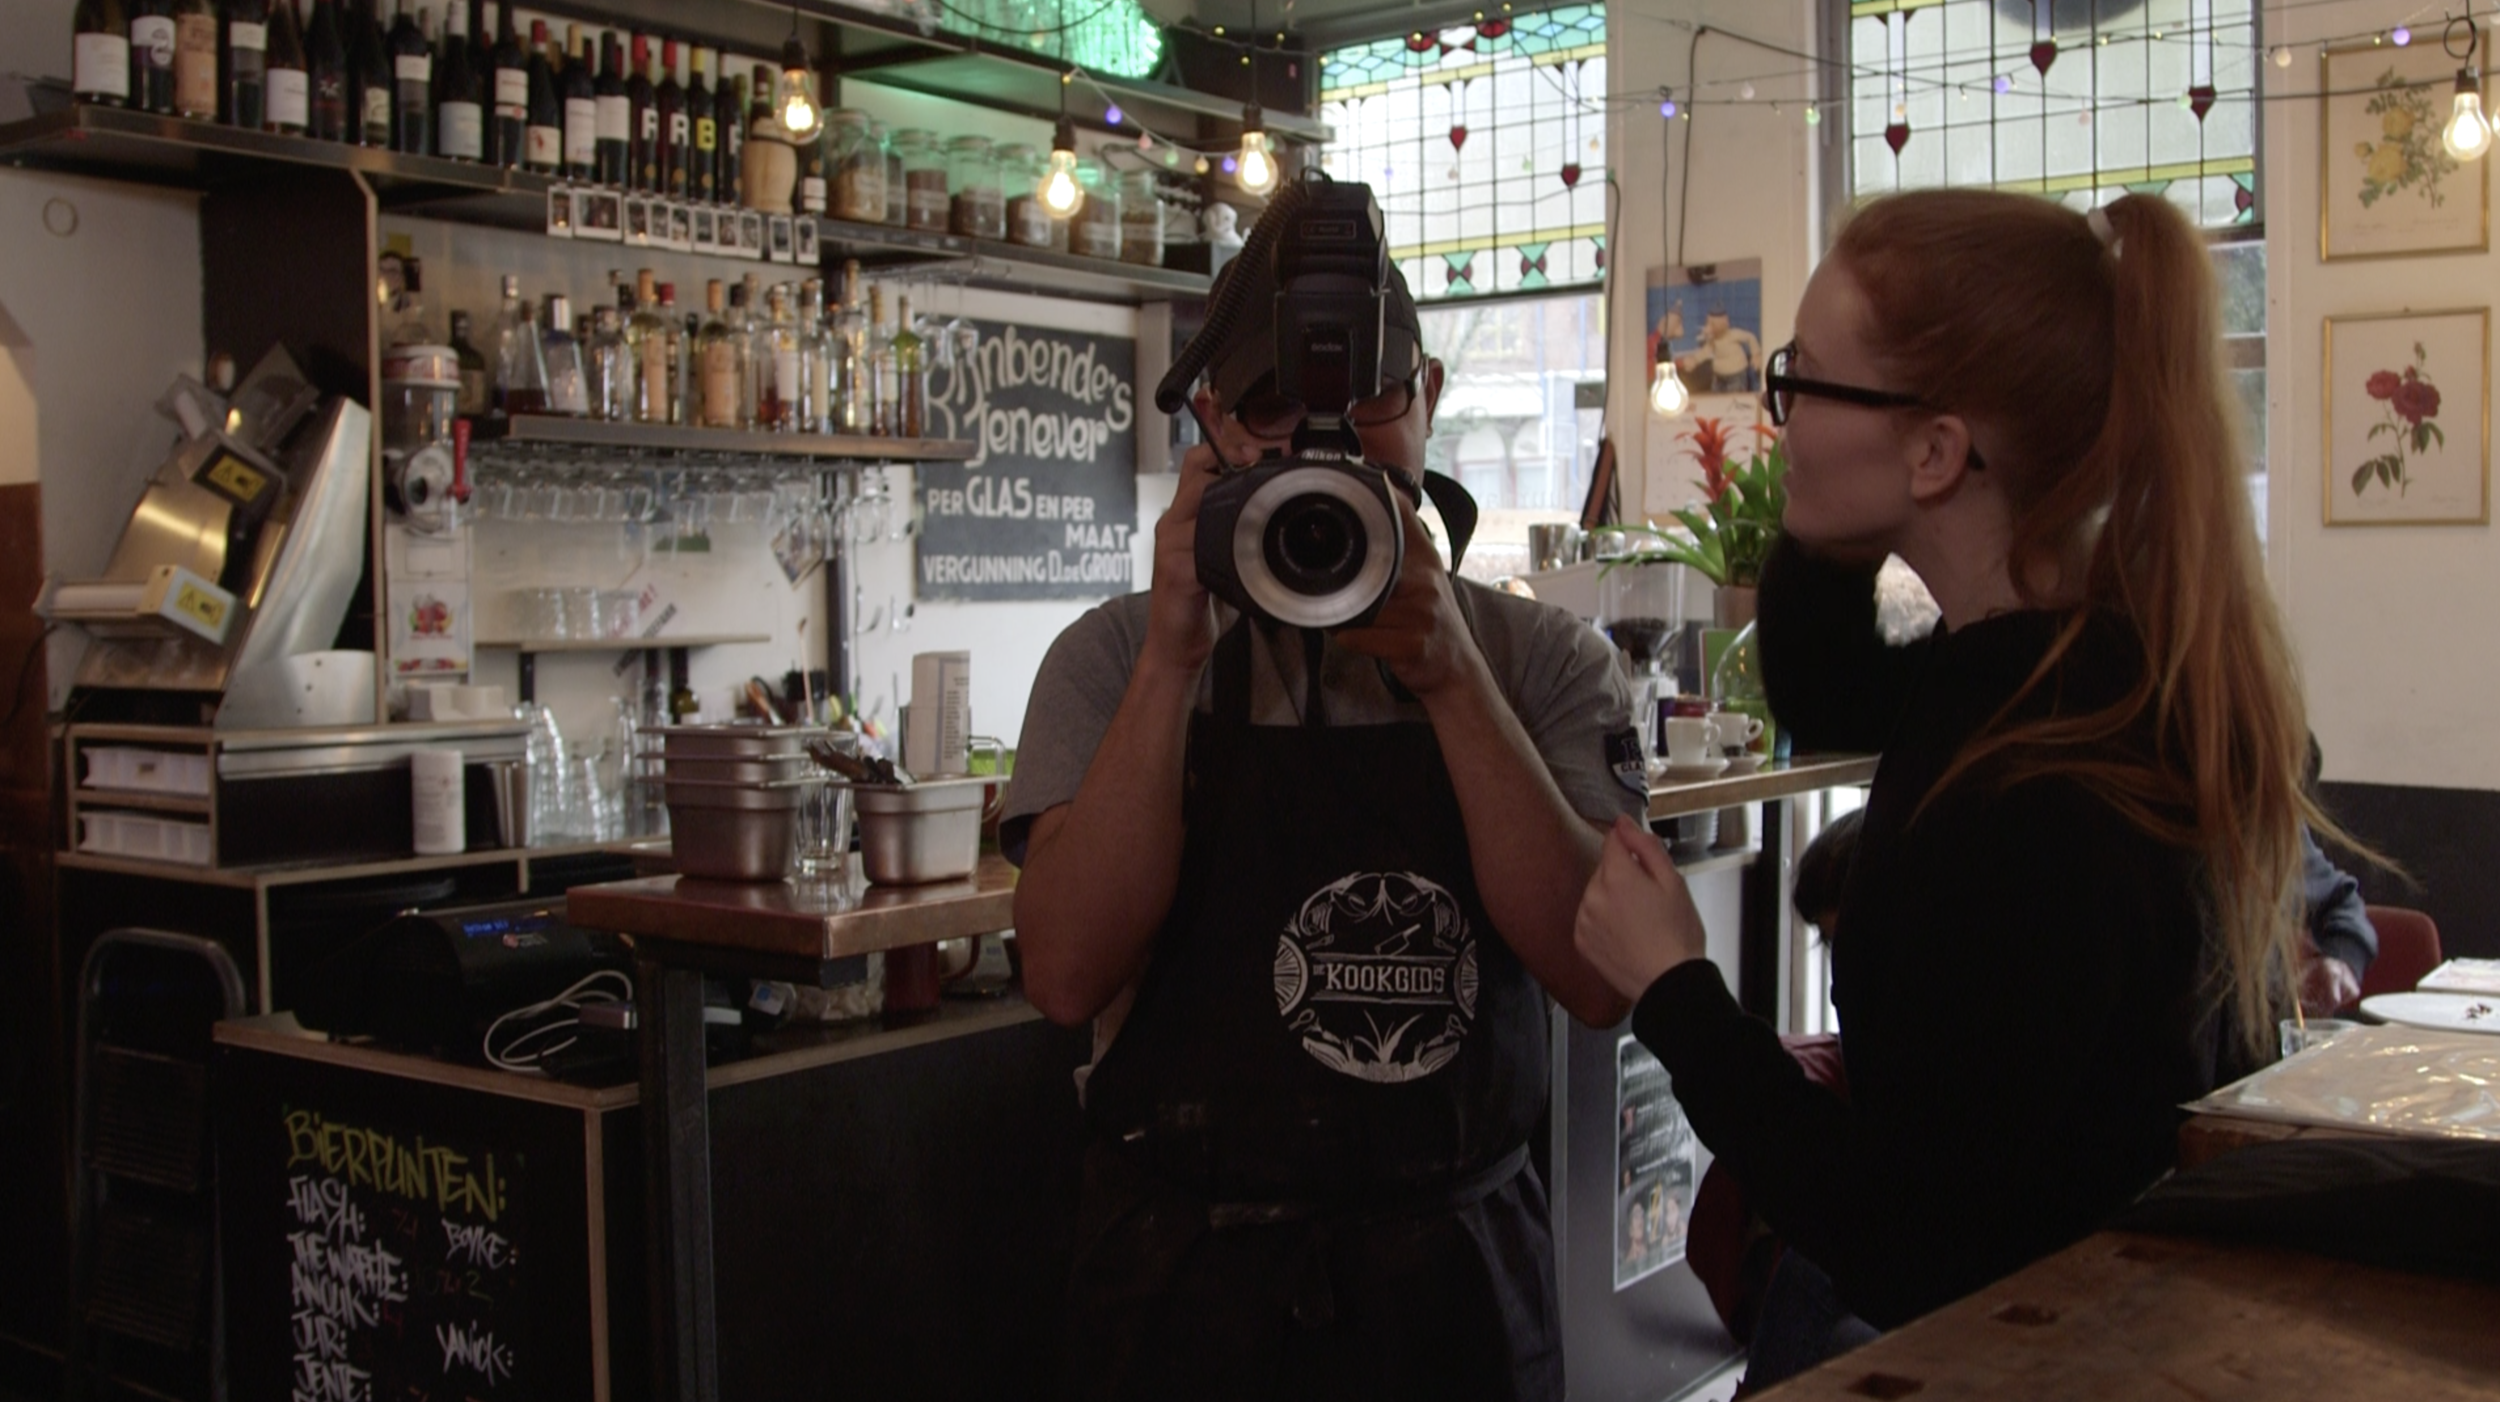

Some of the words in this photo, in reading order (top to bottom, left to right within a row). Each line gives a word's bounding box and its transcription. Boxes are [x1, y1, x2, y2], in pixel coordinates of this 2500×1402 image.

[1302, 449, 1342, 463] Nikon
[926, 488, 965, 517] PER
[965, 475, 1034, 520] GLAS
[1035, 494, 1059, 520] EN
[1061, 496, 1096, 523] PER
[1064, 523, 1130, 551] MAAT
[922, 555, 1047, 584] VERGUNNING
[1325, 962, 1446, 994] KOOKGIDS
